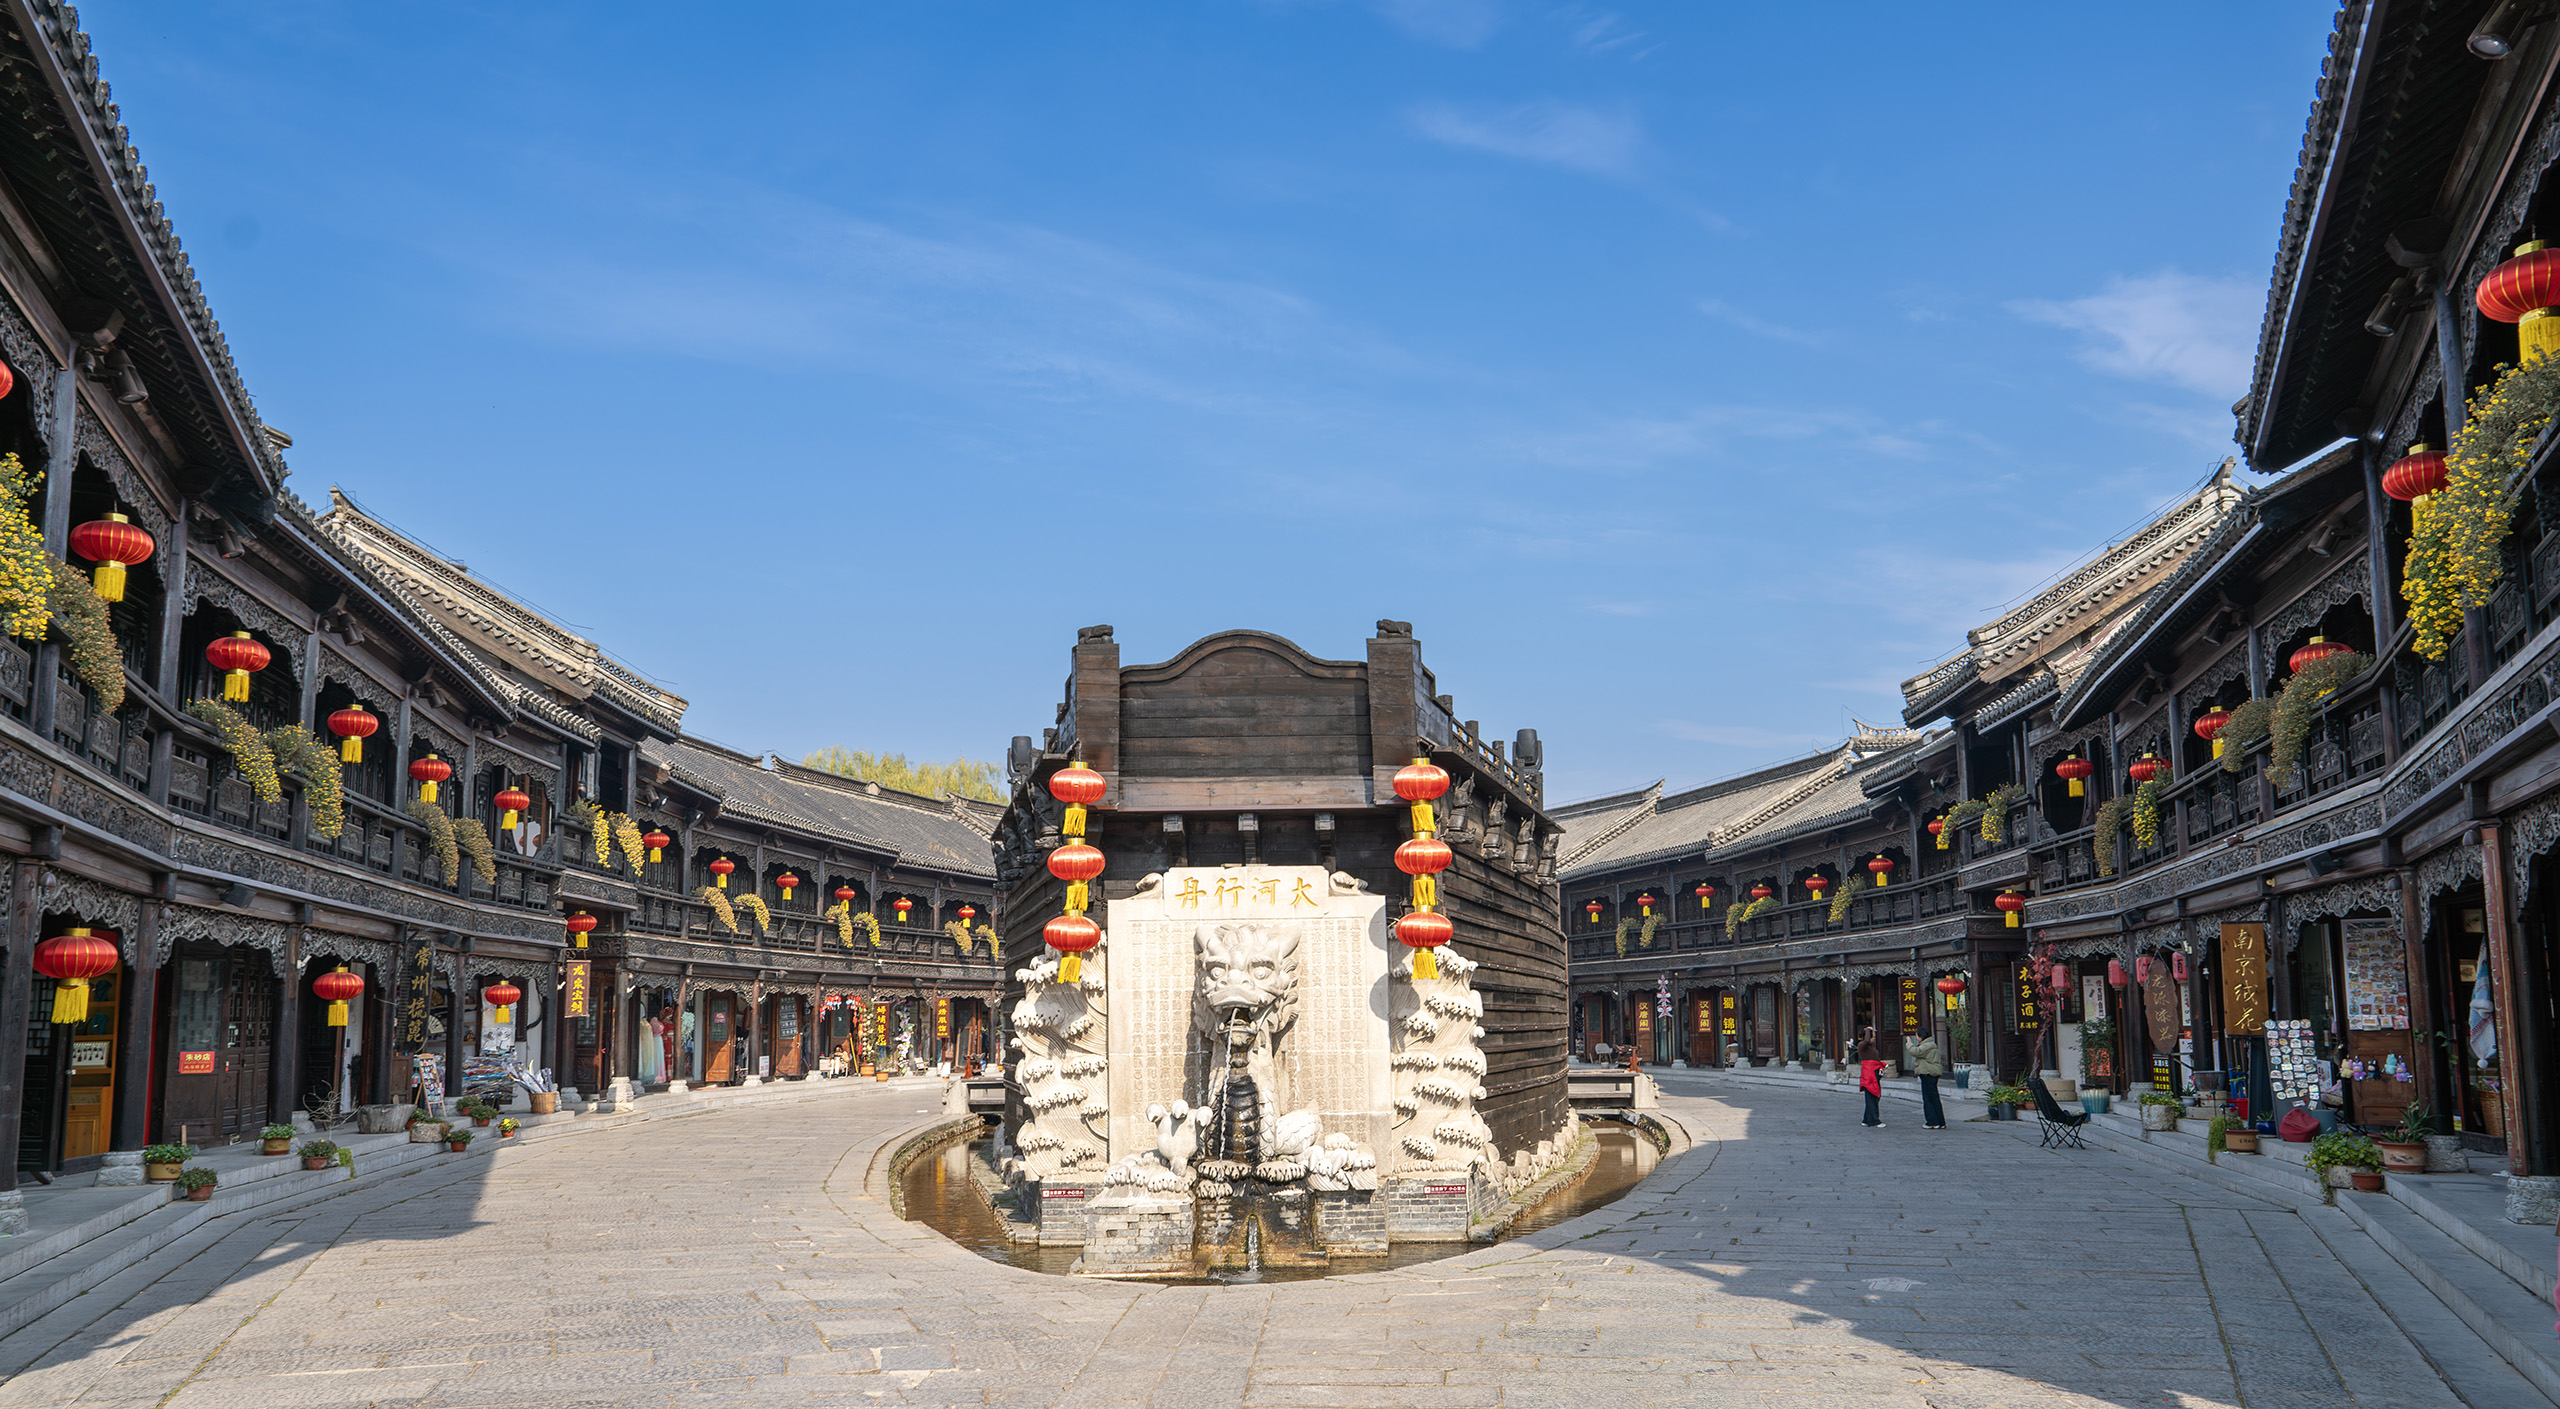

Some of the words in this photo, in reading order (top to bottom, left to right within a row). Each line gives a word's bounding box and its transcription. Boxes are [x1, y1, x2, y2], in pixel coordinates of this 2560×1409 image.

[1175, 876, 1318, 910] 大河行舟
[407, 946, 432, 1042] 常州梳篦
[571, 964, 586, 1013] 龙泉宝剑
[1902, 980, 1918, 1026] 云南蜡染
[2019, 966, 2034, 1017] 木子酒
[2232, 929, 2262, 1031] 南京绒花
[1723, 997, 1735, 1029] 蜀锦
[185, 1053, 210, 1061] 朱砂店
